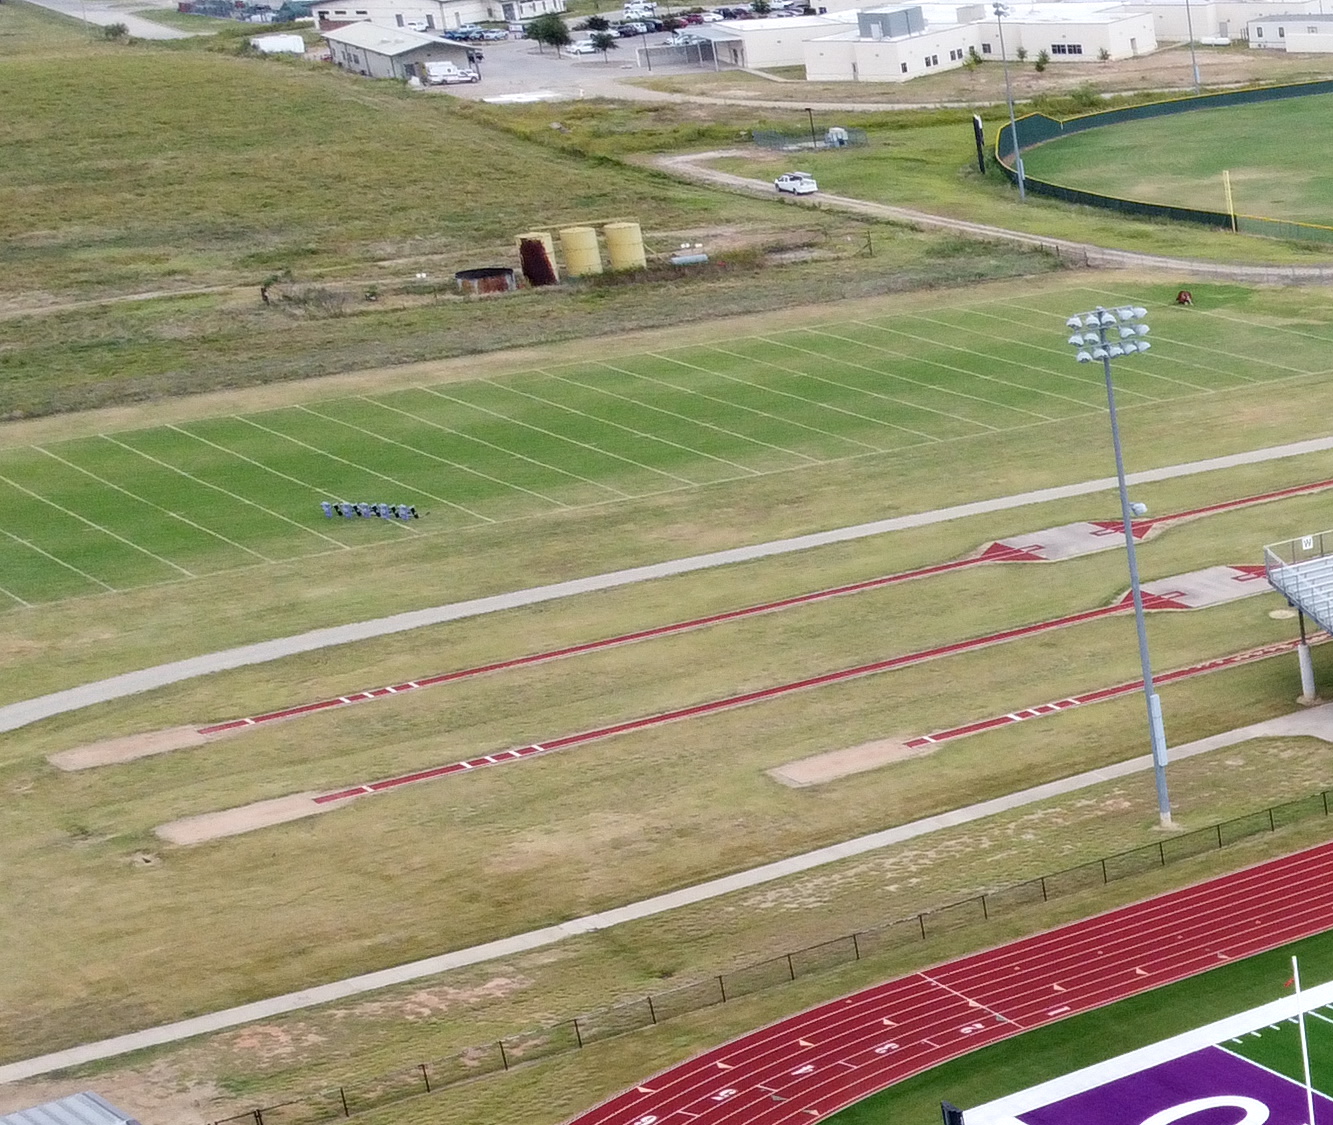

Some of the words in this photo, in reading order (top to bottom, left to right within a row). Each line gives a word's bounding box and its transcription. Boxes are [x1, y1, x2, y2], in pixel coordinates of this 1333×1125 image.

[1047, 1006, 1071, 1016] 1
[960, 1022, 985, 1034] 2
[874, 1042, 900, 1054] 3
[791, 1064, 815, 1076] 4
[711, 1088, 738, 1101] 5
